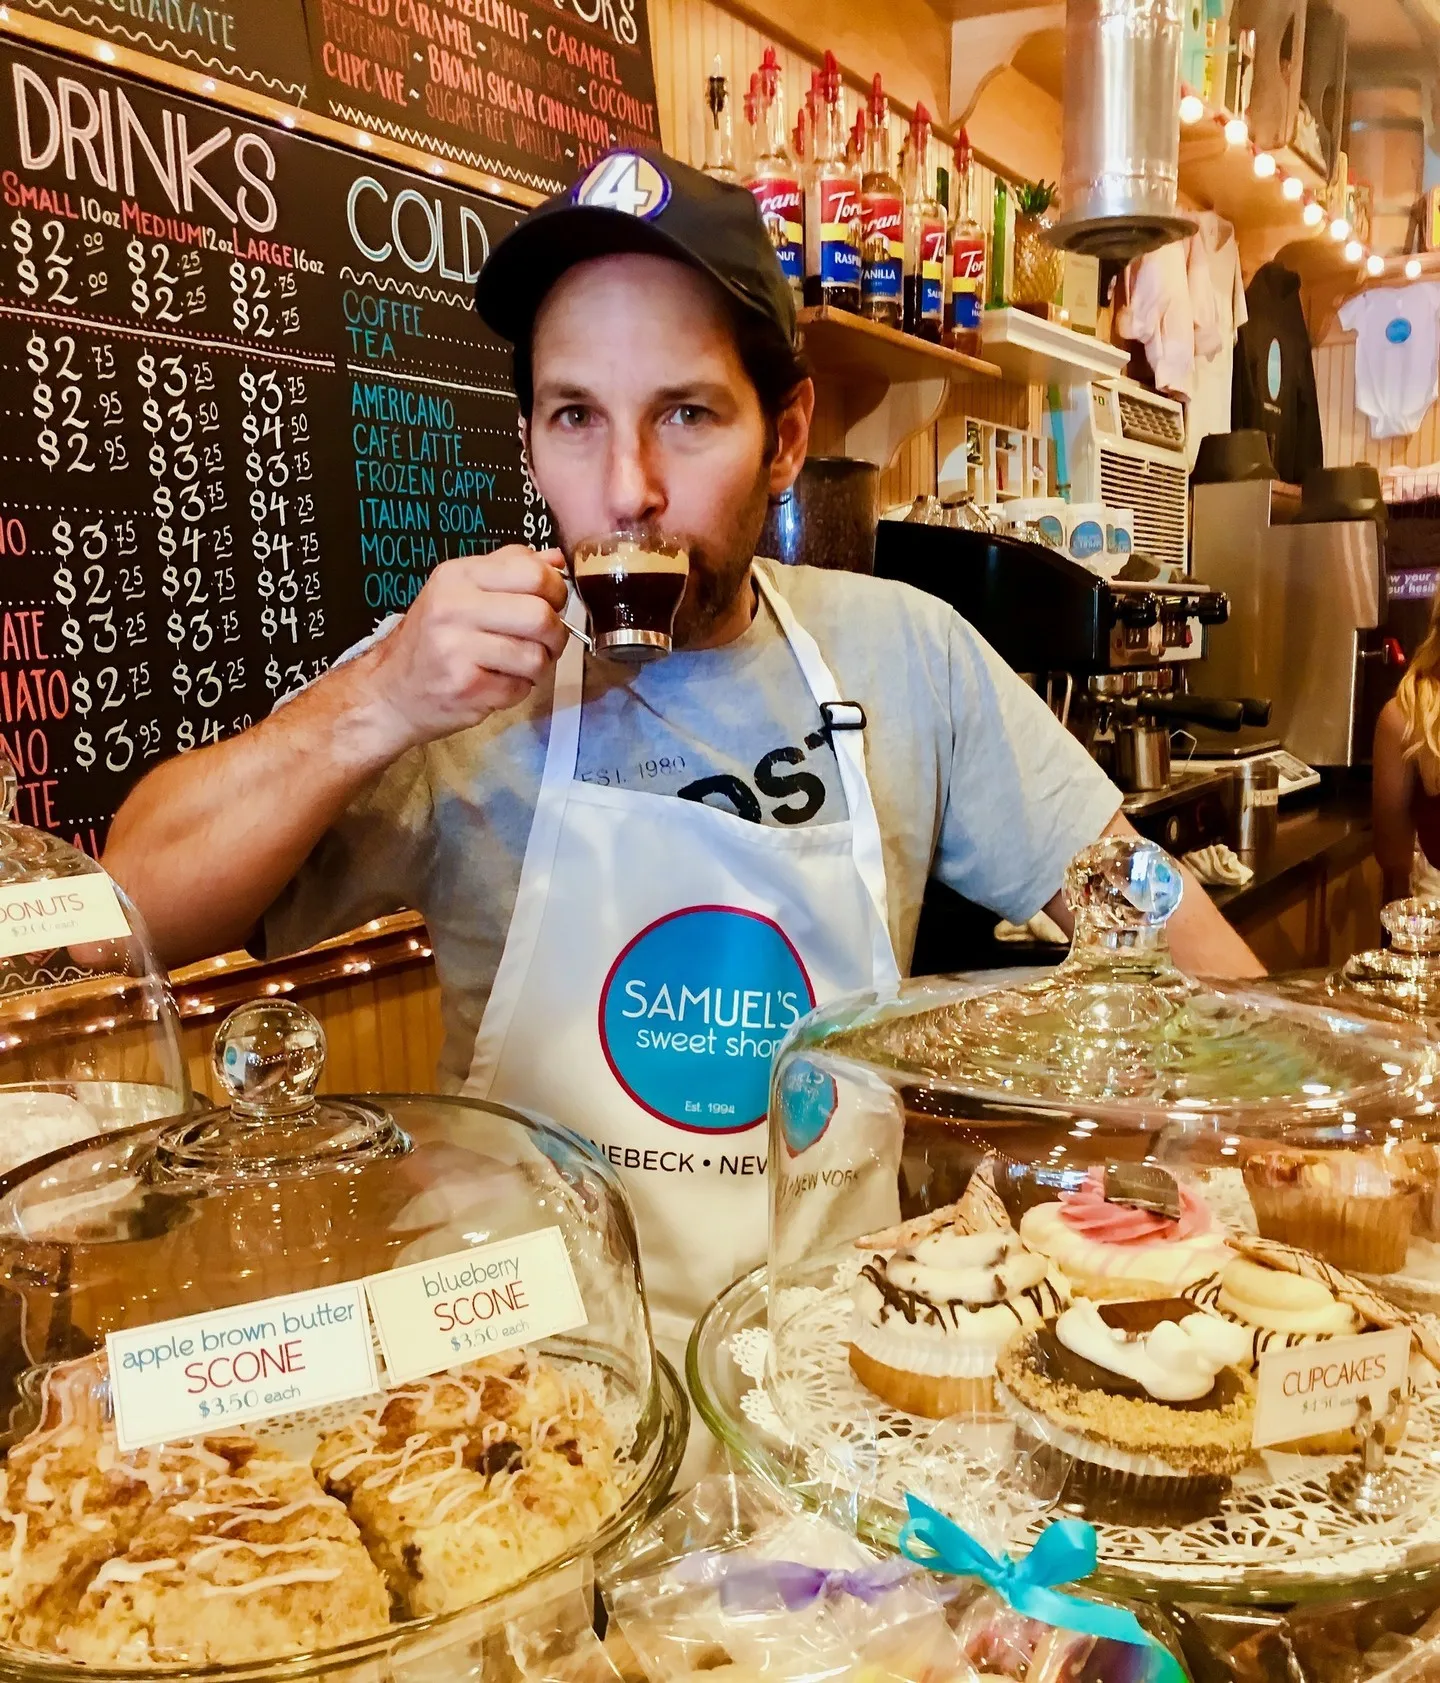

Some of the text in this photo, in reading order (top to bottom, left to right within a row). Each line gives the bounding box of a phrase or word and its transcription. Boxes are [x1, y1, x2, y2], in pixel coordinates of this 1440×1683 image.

[322, 1, 411, 70] PEPPERMINT
[427, 43, 484, 100] BROWN
[486, 71, 537, 122] SUGAR
[538, 94, 610, 149] CINNAMON
[395, 0, 477, 58] CARAMEL
[589, 79, 654, 132] COCONUT
[546, 25, 622, 84] CARAMEL
[323, 41, 407, 107] CUPCAKE
[512, 116, 564, 165] VANILLA
[12, 62, 277, 233] DRINKS
[583, 153, 652, 216] 4
[752, 184, 800, 213] rani
[347, 176, 490, 283] COLD
[861, 208, 900, 234] rani
[343, 290, 424, 338] COFFEE
[345, 326, 397, 361] TEA
[352, 381, 454, 430] AMERICANO
[353, 424, 464, 467] CAFÉ LATTE
[356, 460, 435, 495] FROZEN
[442, 470, 496, 500] CAPPY
[359, 498, 430, 531] ITALIAN
[439, 502, 486, 533] SODA
[361, 533, 439, 568] MOCHA
[621, 979, 800, 1030] SAMUEL'S
[636, 1028, 717, 1056] sweet
[685, 1100, 736, 1115] Est. 1994
[422, 1256, 519, 1298] blueberry
[434, 1280, 530, 1332] SCONE
[122, 1302, 355, 1373] apple brown butter
[450, 1319, 530, 1352] $3.50 each
[184, 1339, 306, 1394] SCONE
[1283, 1353, 1386, 1397] CUPCAKES
[198, 1384, 301, 1419] $3.50 each
